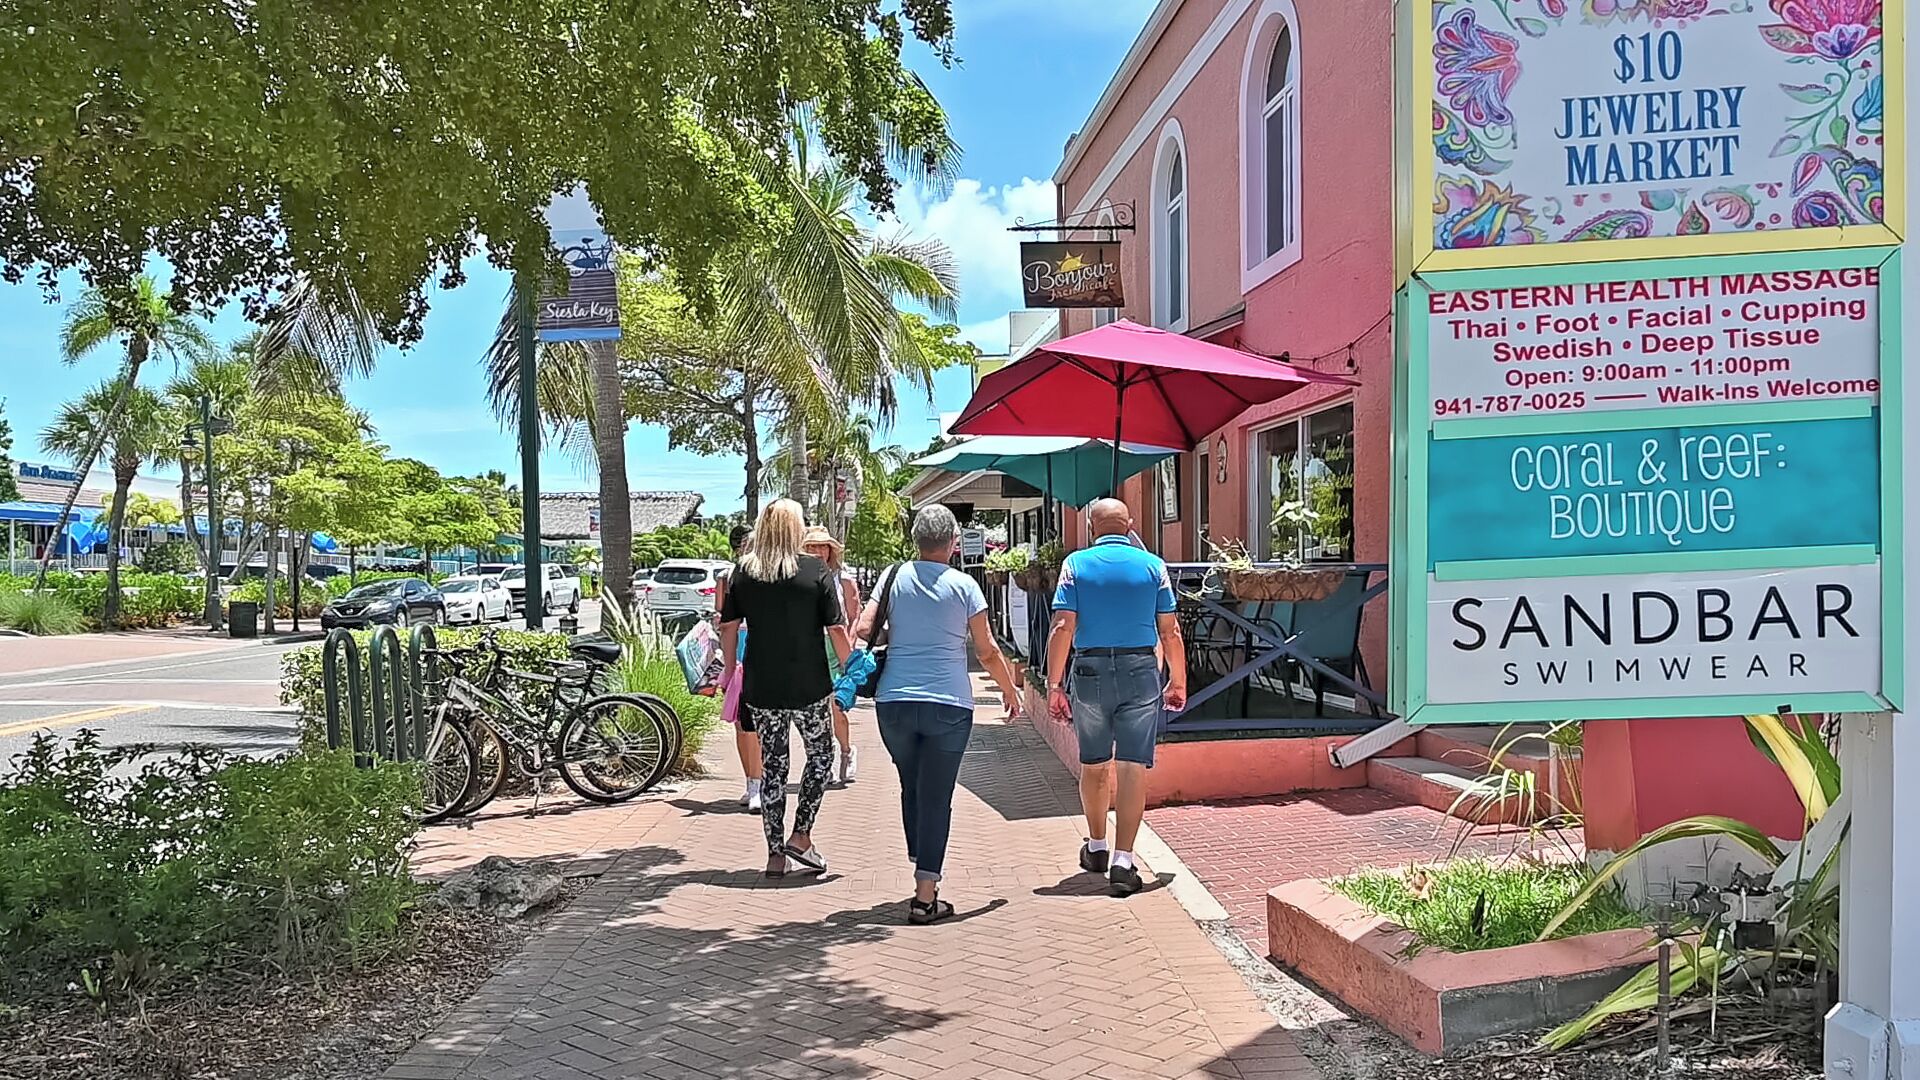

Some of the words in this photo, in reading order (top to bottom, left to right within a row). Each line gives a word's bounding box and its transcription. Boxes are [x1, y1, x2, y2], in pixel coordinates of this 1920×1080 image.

[1614, 30, 1682, 84] $10
[1554, 86, 1746, 139] JEWELRY
[1564, 136, 1740, 186] MARKET
[1023, 261, 1116, 293] Bonjour
[1428, 285, 1574, 314] EASTERN
[1586, 276, 1710, 304] HEALTH
[1721, 266, 1879, 295] MASSAGE
[546, 302, 589, 319] Siesta
[591, 301, 613, 323] Key
[1448, 317, 1507, 339] Thai
[1536, 312, 1599, 334] Foot
[1628, 304, 1711, 329] Facial
[1741, 297, 1865, 324] Cupping
[1493, 337, 1612, 362] Swedish
[1641, 333, 1714, 355] Deep
[1723, 328, 1820, 349] Tissue
[1505, 369, 1574, 389] Open:
[1582, 363, 1666, 382] 9:00am
[1690, 356, 1790, 376] 11:00pm
[1434, 391, 1586, 415] 941-787-0025
[1658, 383, 1760, 403] Walk-Ins
[1767, 378, 1879, 397] Welcome
[1637, 438, 1667, 485] &
[1452, 584, 1859, 651] SANDBAR
[1504, 653, 1808, 686] SWIMWEAR
